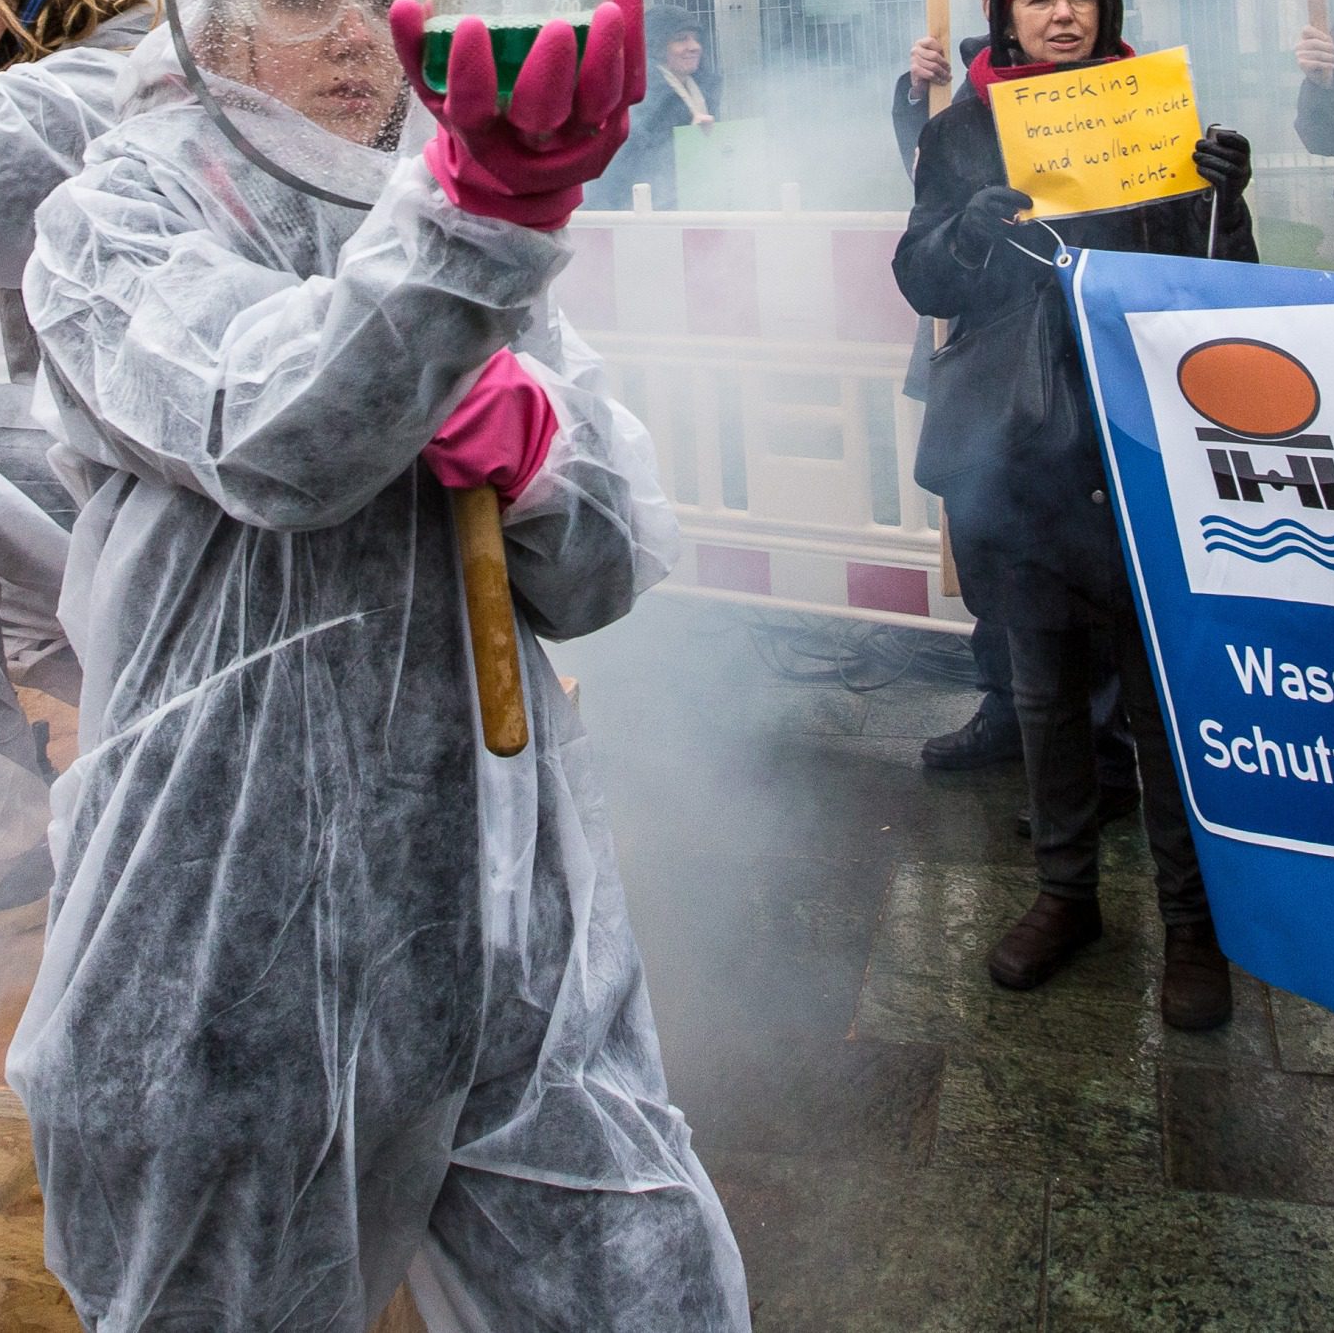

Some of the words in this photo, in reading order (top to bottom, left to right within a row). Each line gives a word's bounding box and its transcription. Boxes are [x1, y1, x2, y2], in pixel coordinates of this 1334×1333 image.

[1014, 74, 1139, 105] Fracking
[1026, 114, 1106, 139] brauchen
[1114, 109, 1137, 125] wir
[1146, 93, 1190, 116] nicht
[1033, 149, 1072, 174] und
[1084, 138, 1141, 164] wollen
[1150, 135, 1180, 151] wir
[1121, 163, 1177, 191] nicht.
